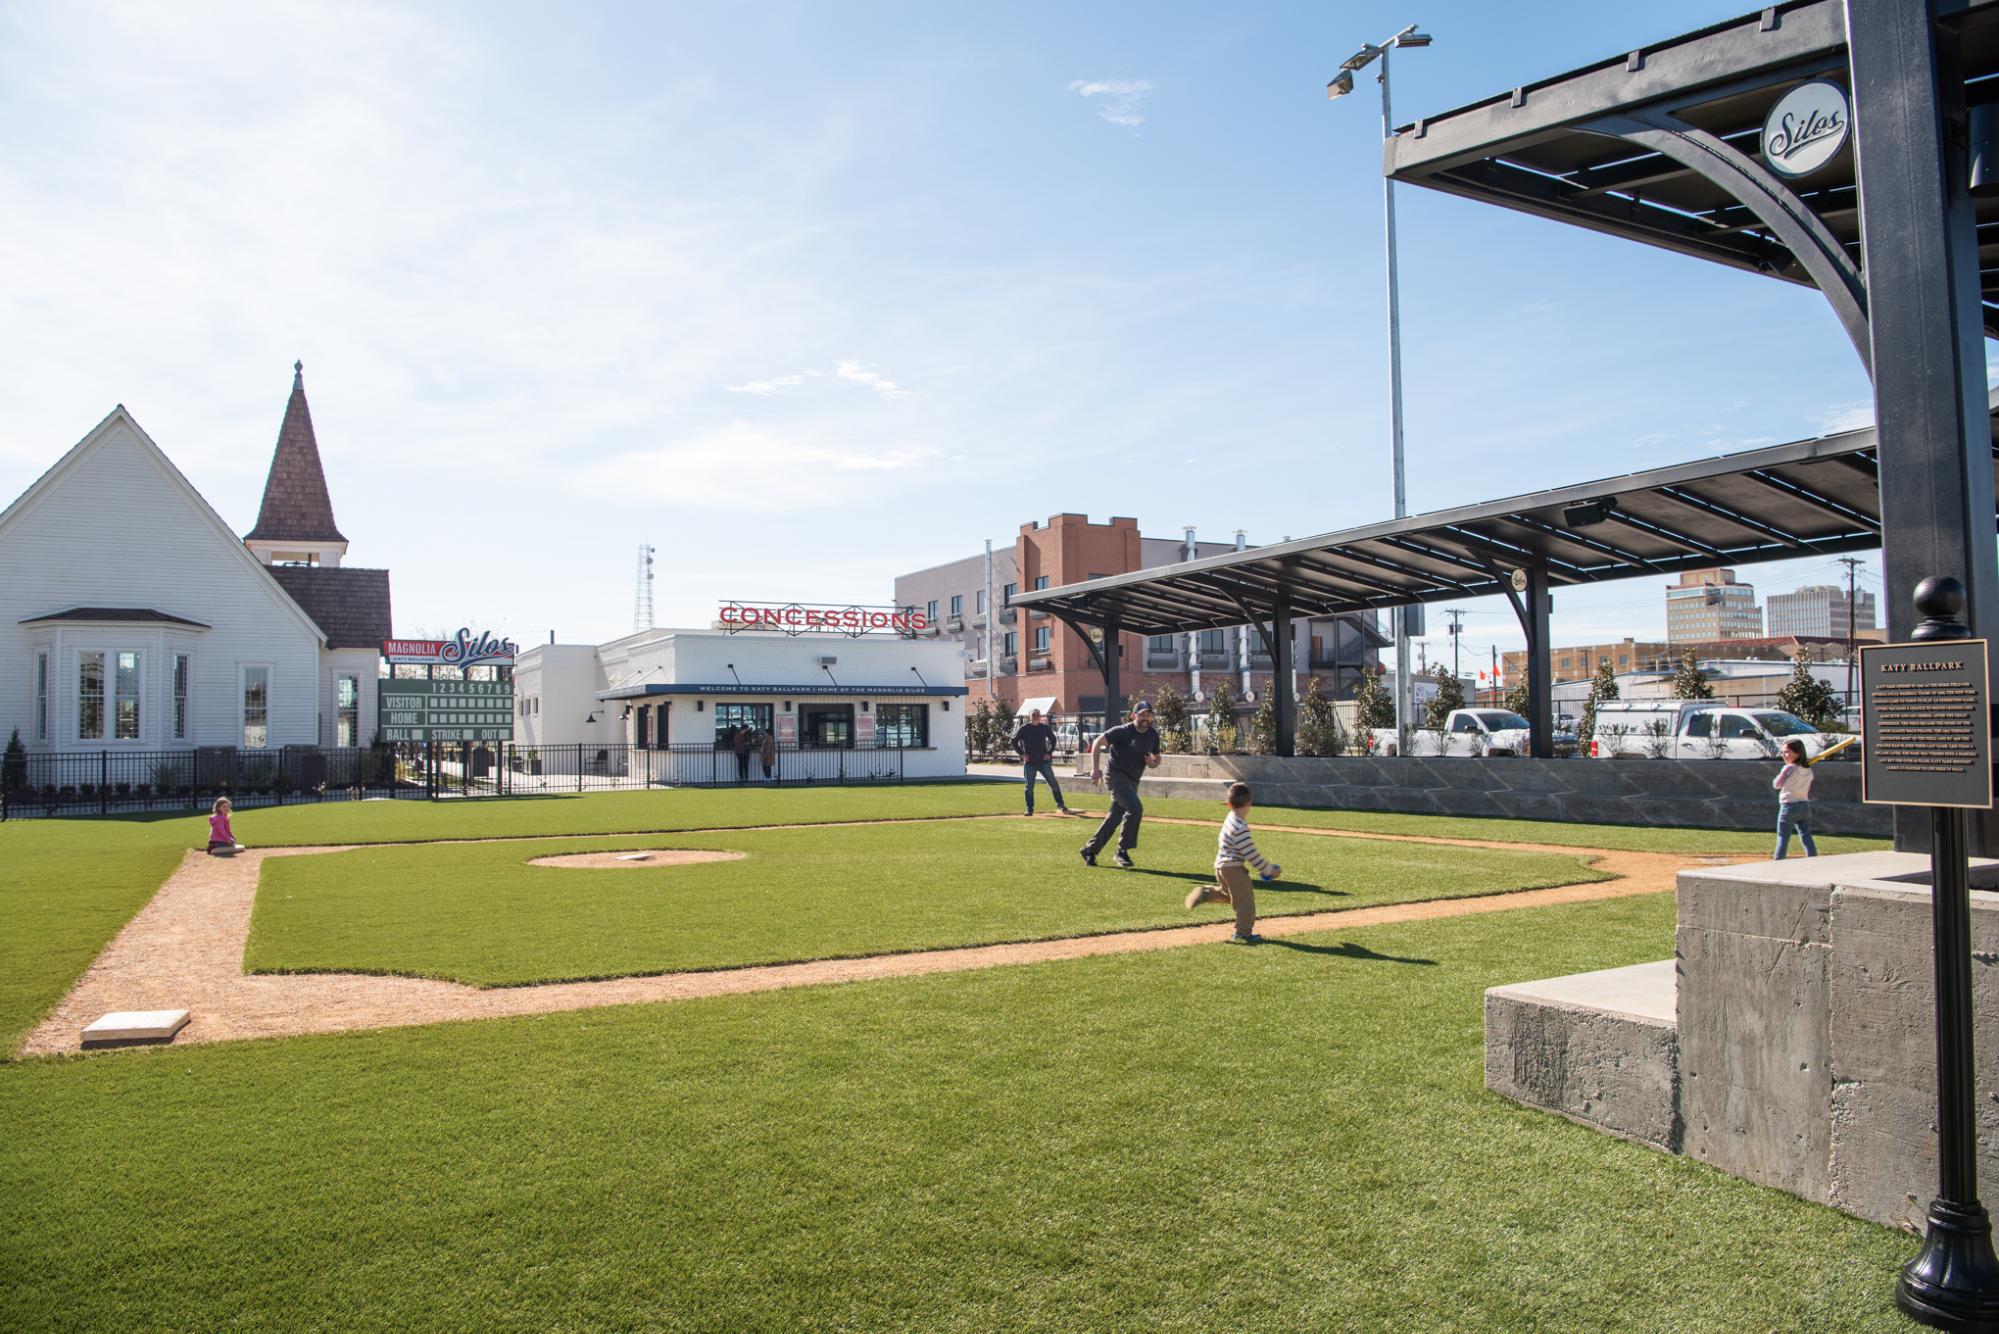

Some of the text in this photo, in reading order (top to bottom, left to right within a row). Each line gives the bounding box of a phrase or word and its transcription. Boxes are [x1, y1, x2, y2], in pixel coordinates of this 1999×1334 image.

[1769, 109, 1844, 159] Silos
[719, 606, 928, 630] CONCESSIONS
[388, 627, 513, 670] MAGNOLIA Silos
[1881, 661, 1964, 672] KATY BALLPARK
[432, 683, 511, 694] 1 2 3 4 5 6 7 8 9
[386, 697, 422, 708] VISITOR
[391, 712, 418, 724] HOME
[386, 729, 498, 740] BALL STRIKE OUT
